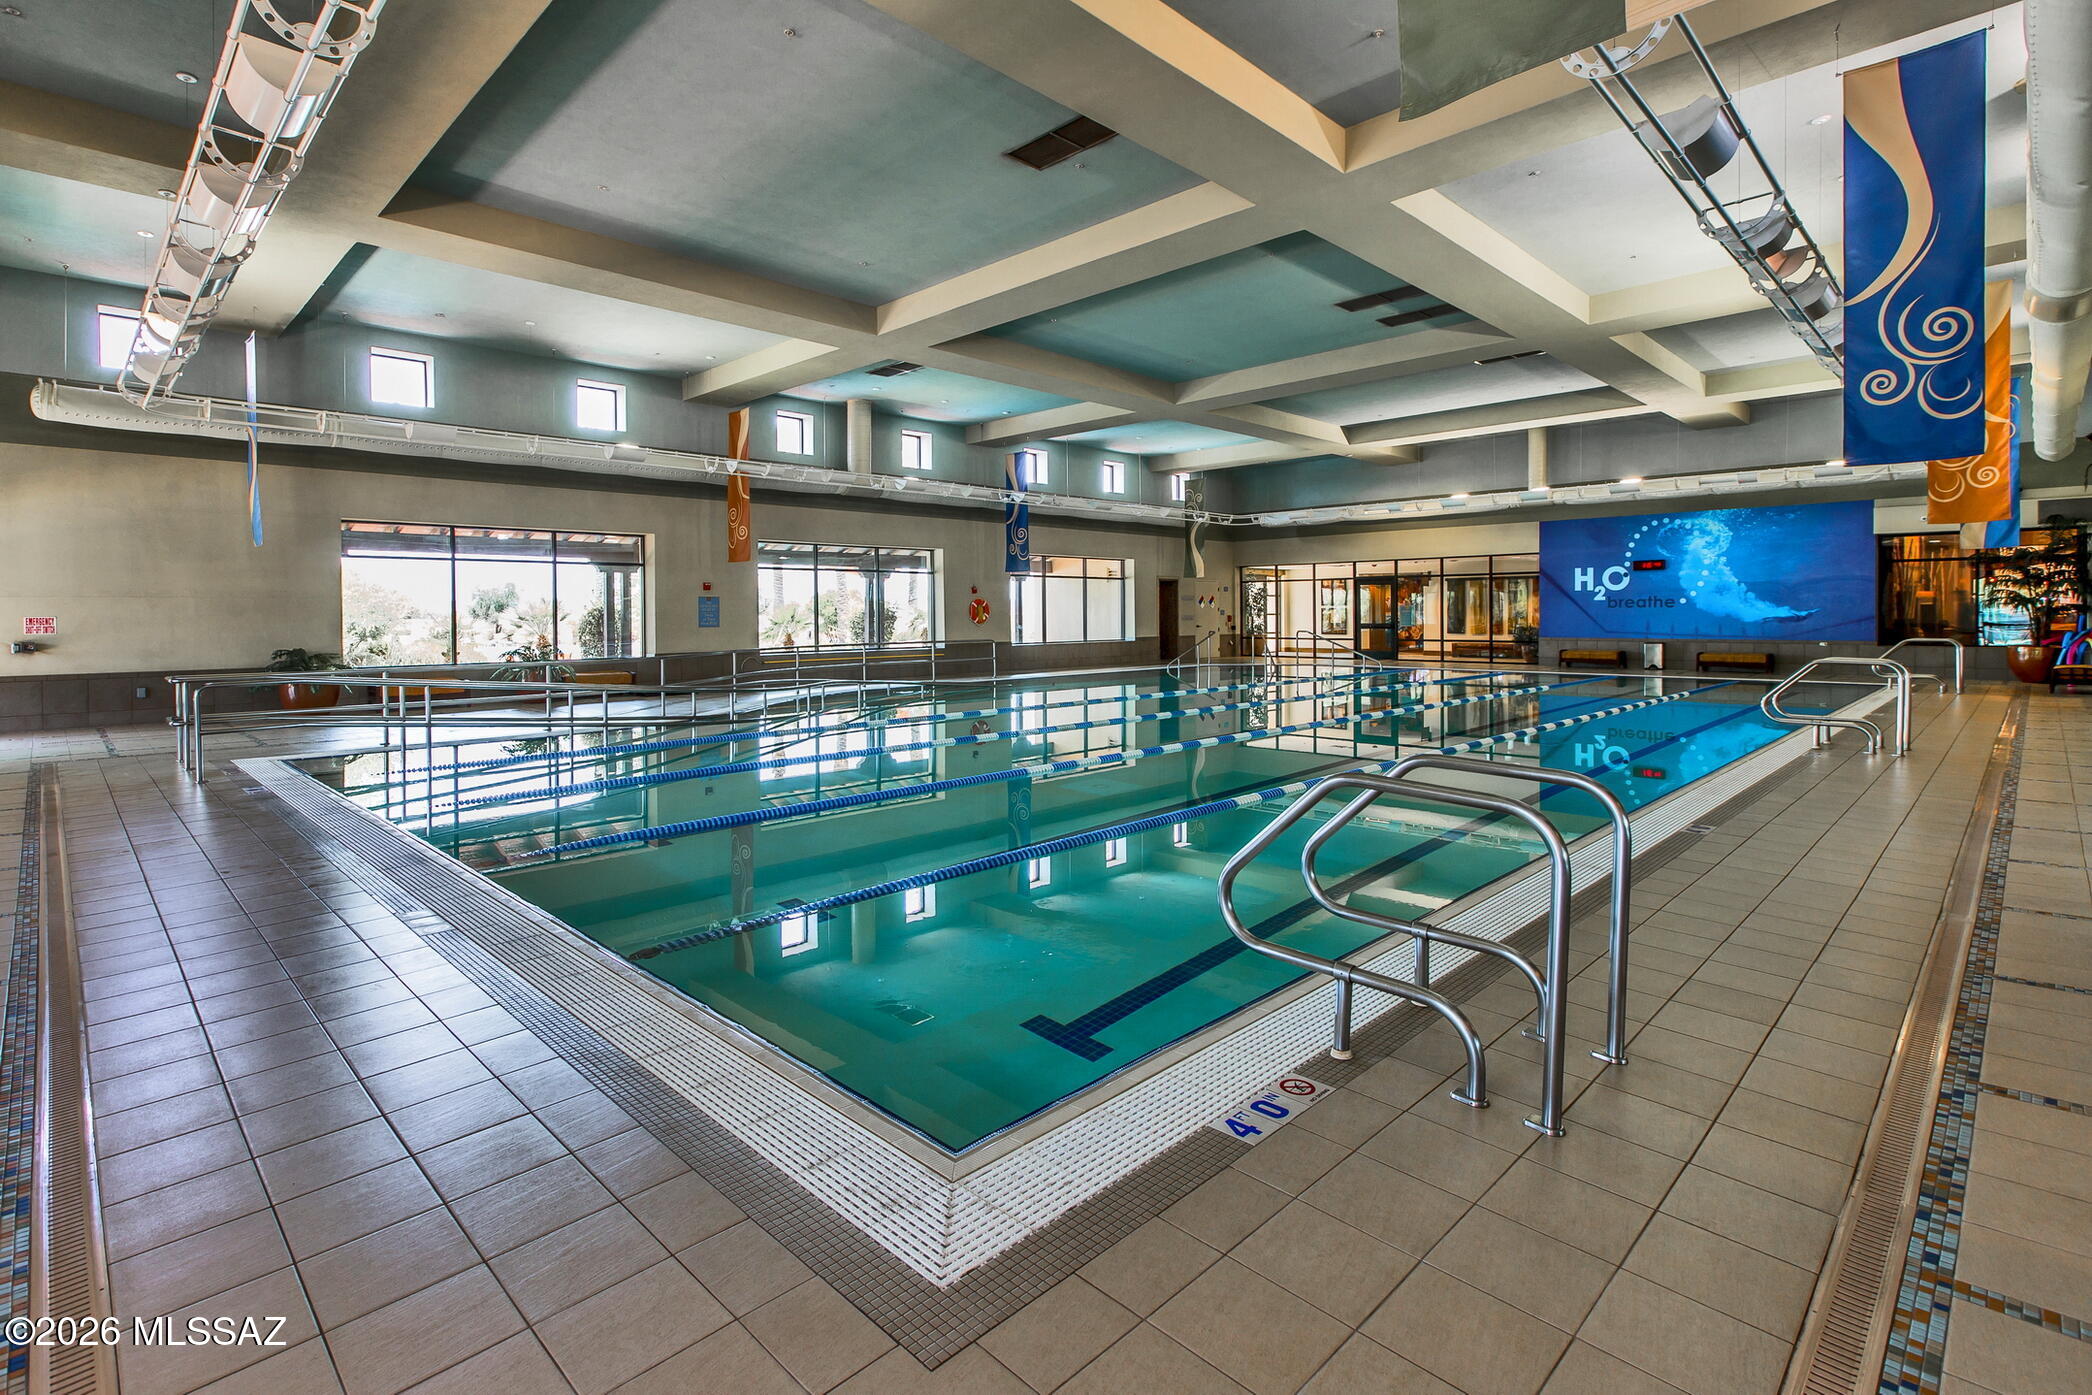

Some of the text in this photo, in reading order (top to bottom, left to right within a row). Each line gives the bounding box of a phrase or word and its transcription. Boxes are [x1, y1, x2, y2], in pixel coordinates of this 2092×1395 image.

[1574, 565, 1630, 601] H2O
[1606, 596, 1676, 608] breathe
[25, 617, 55, 626] EMERGENCY
[1224, 1118, 1264, 1138] 4
[1249, 1099, 1290, 1119] 0
